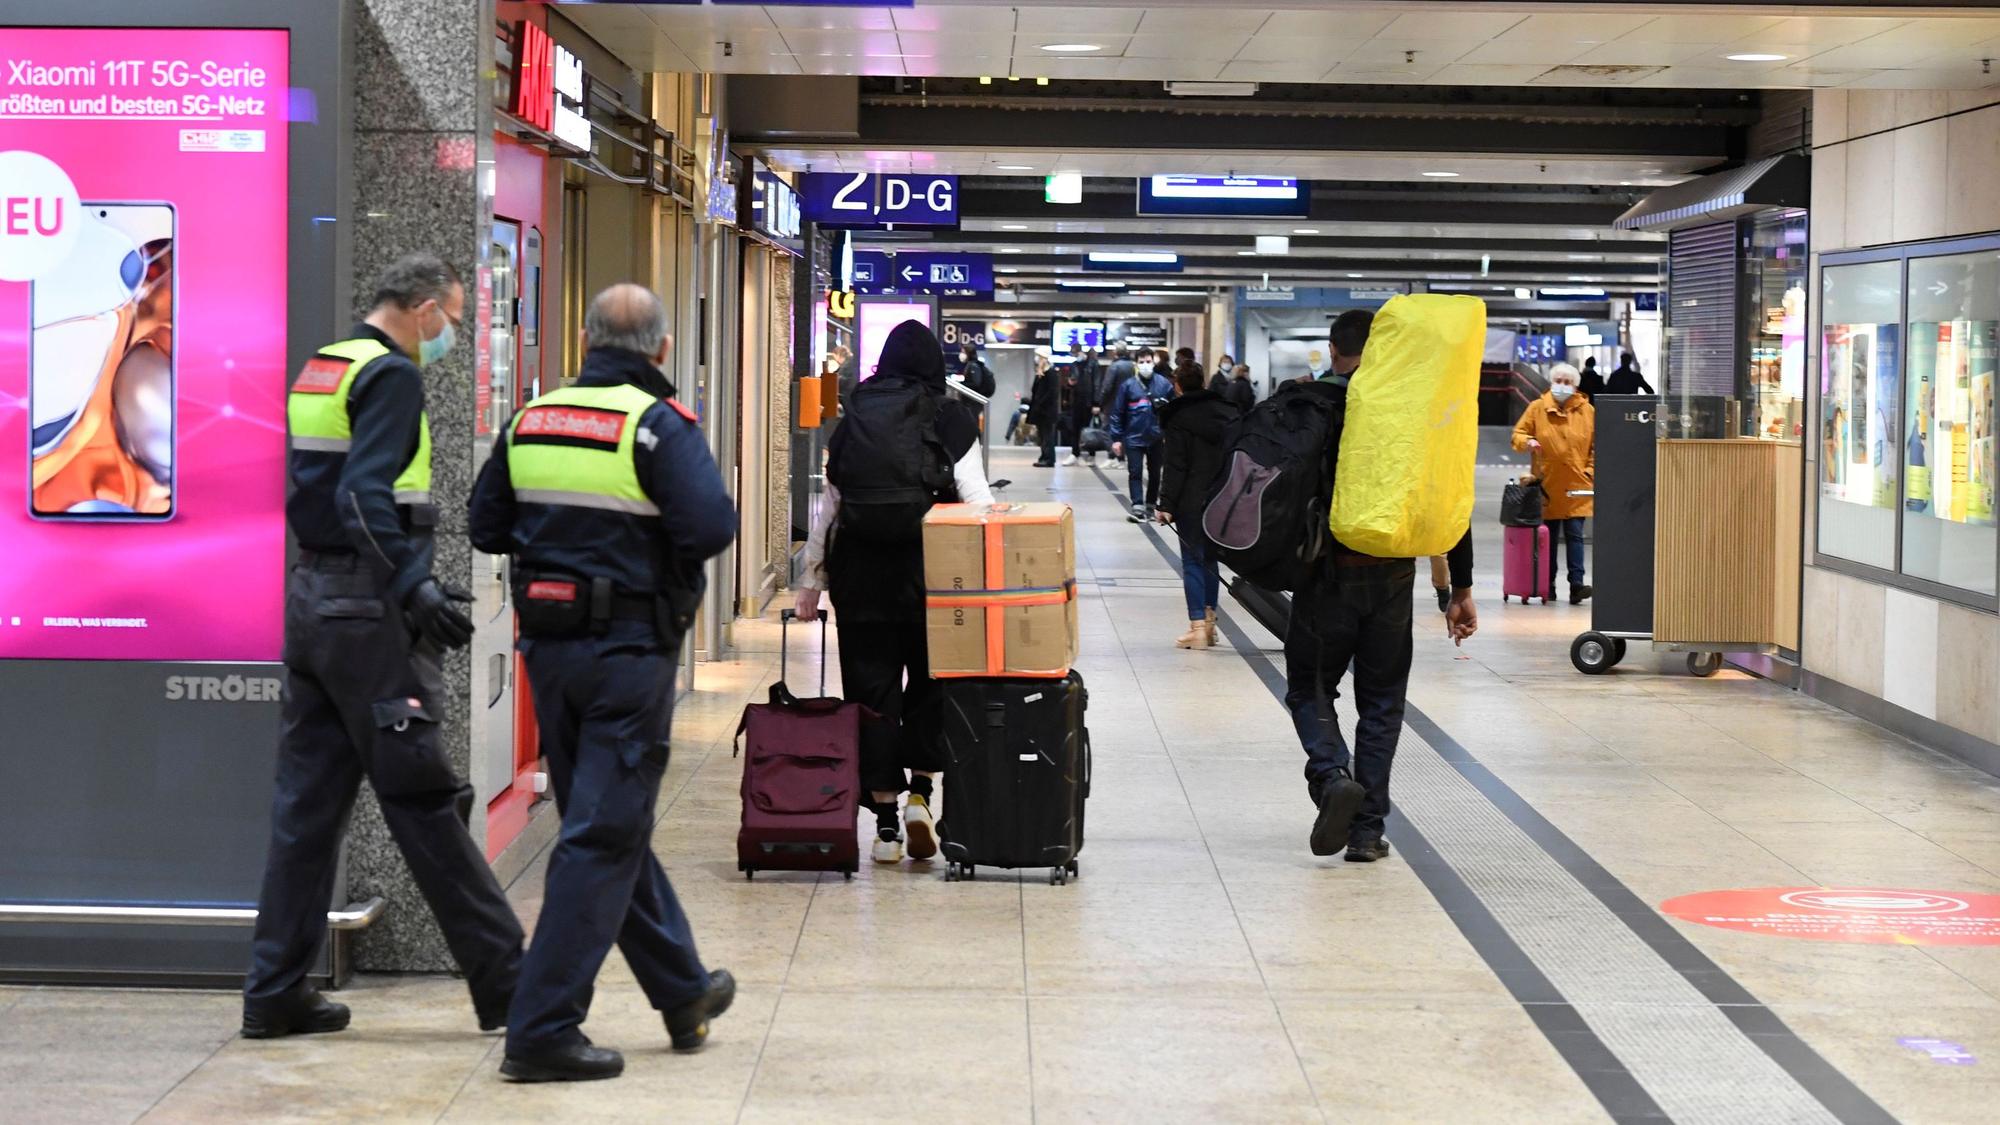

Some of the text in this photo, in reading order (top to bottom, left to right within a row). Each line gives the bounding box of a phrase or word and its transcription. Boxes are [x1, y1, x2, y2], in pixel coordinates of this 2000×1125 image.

[7, 60, 266, 87] Xiaomi 11T 5G-Serie
[0, 93, 265, 116] rößten und besten 5G-Netz
[886, 179, 953, 212] D-G
[0, 197, 64, 237] EU
[944, 323, 985, 345] 8 D-G
[953, 576, 965, 626] BO 20
[165, 674, 282, 702] STRÖER
